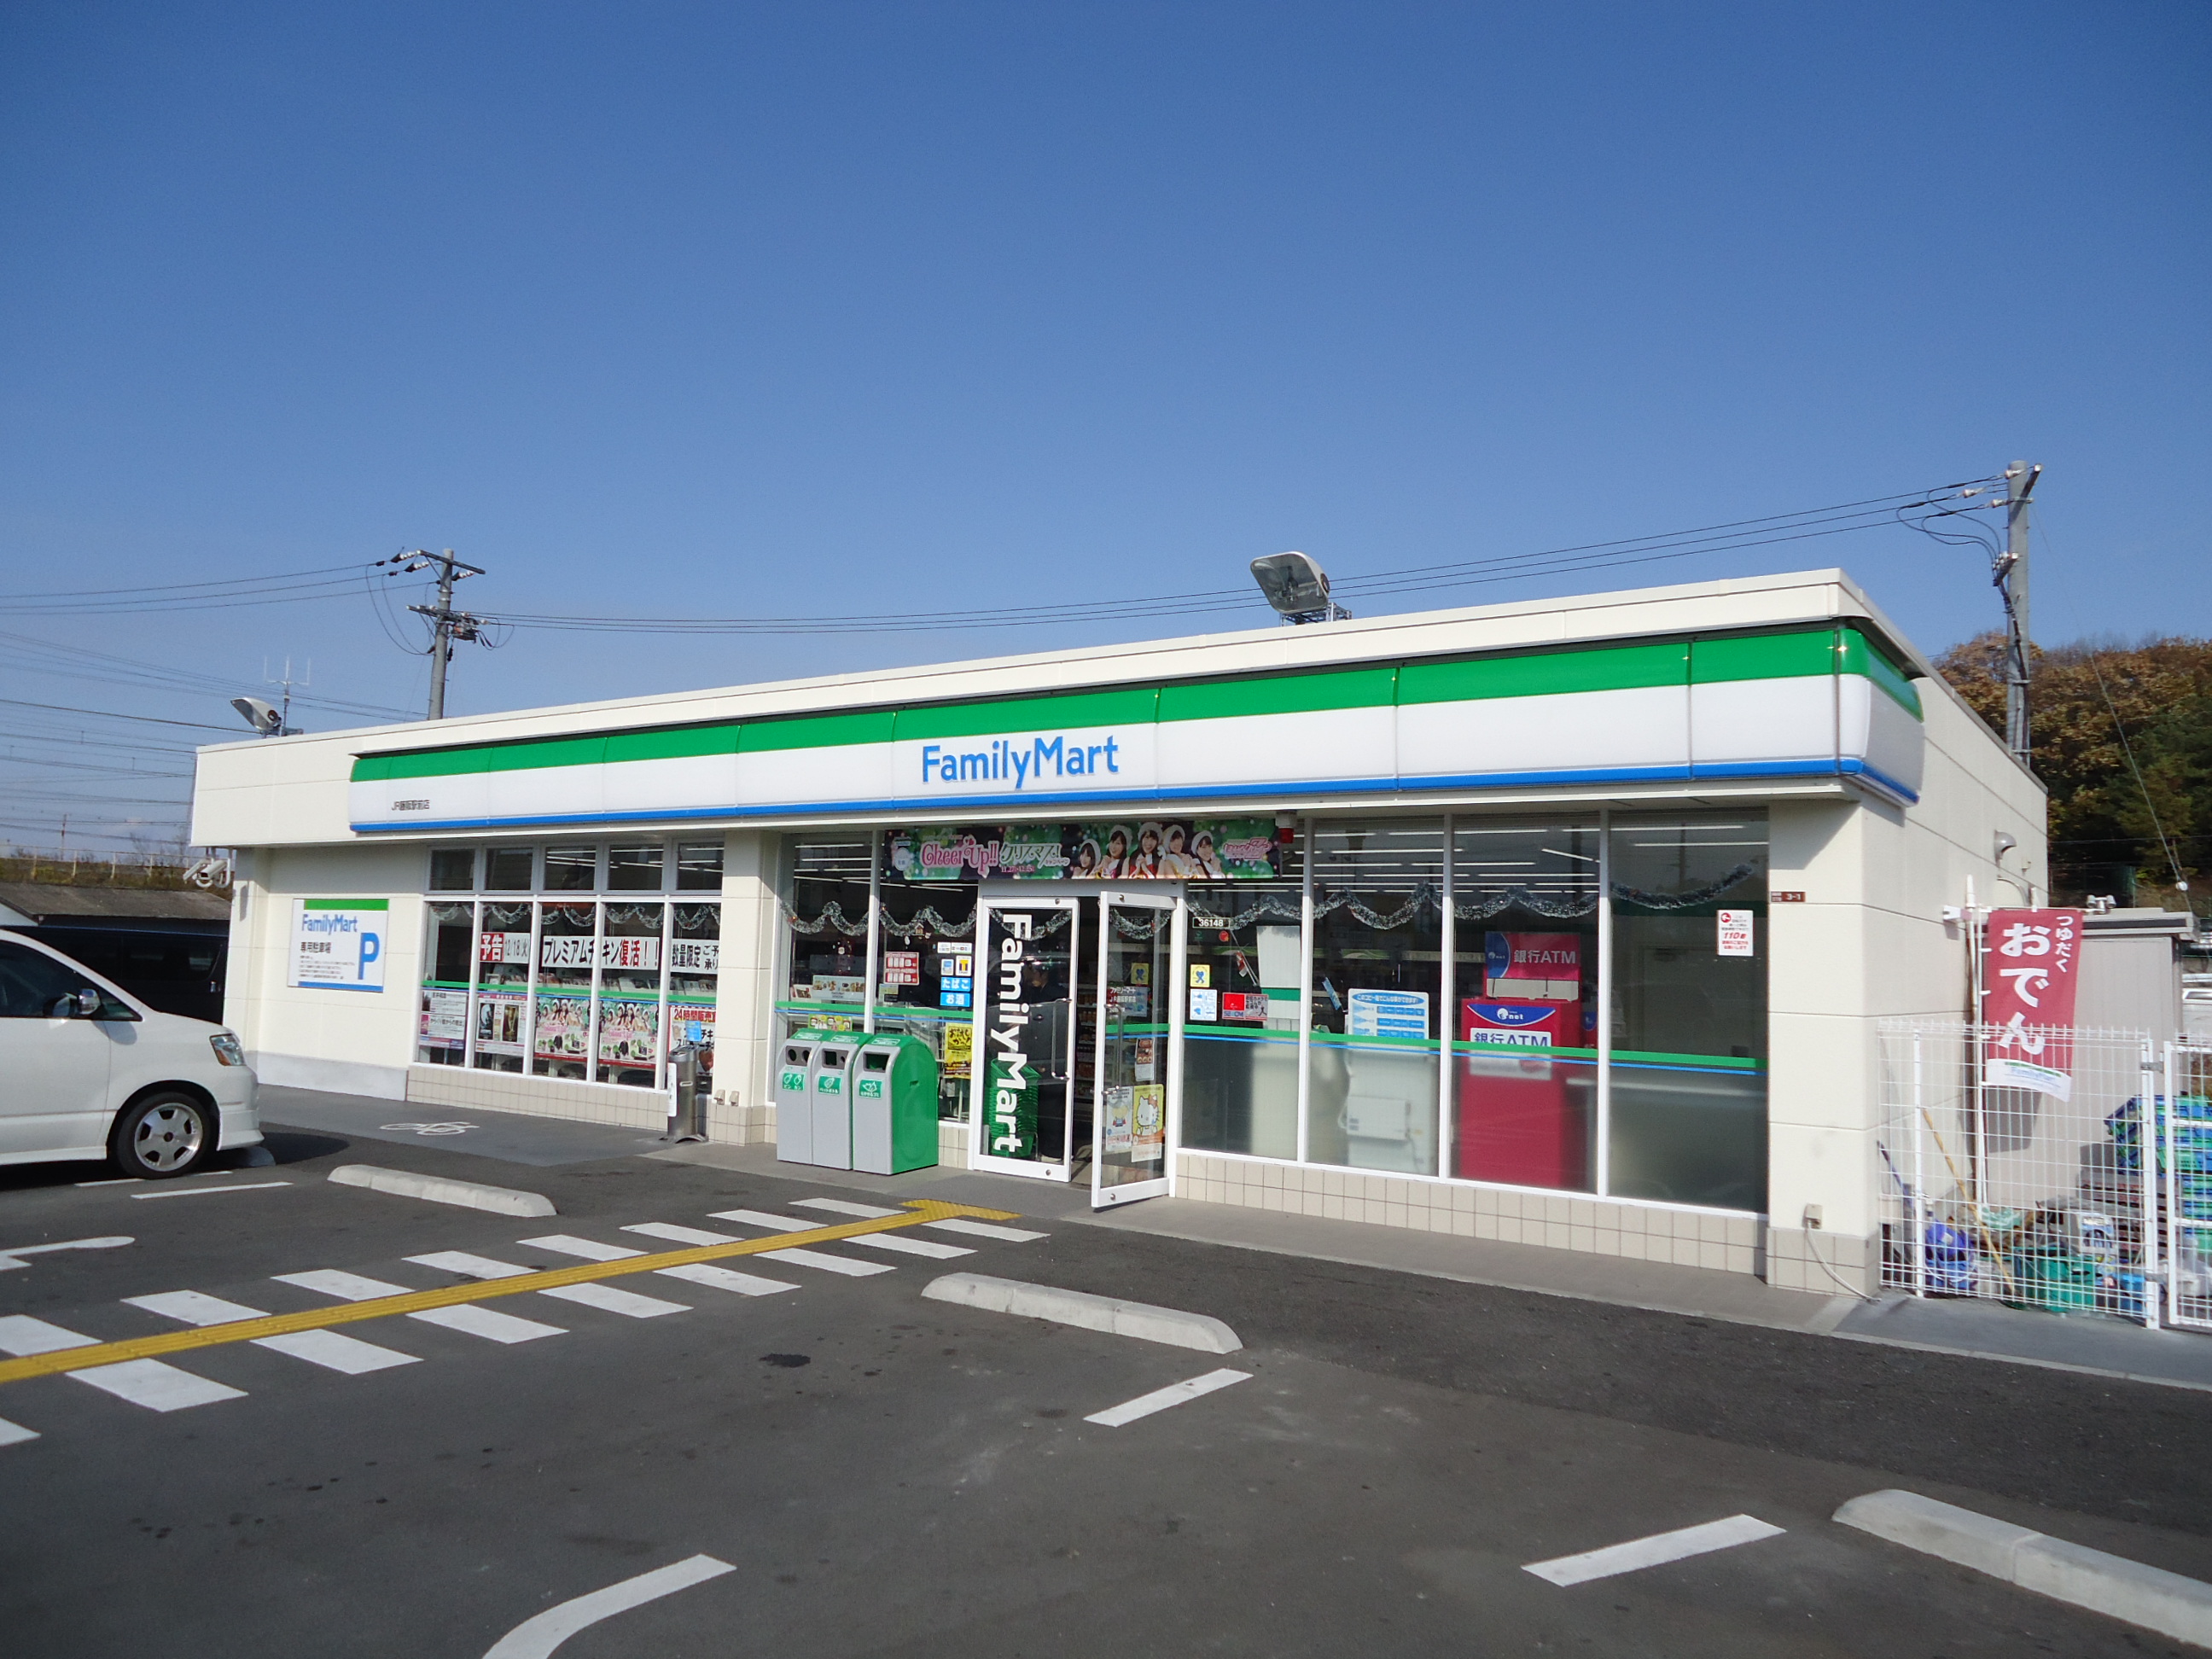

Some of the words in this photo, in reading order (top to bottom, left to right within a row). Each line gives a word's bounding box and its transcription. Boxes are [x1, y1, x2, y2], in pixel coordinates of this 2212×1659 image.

[923, 735, 1119, 789] FamilyMart
[922, 843, 963, 866] Cheer
[301, 913, 358, 935] FamilyMart
[358, 932, 381, 980] P
[480, 934, 503, 961] 予告
[672, 944, 701, 968] 数量限定
[2055, 916, 2074, 973] つゆだく
[1514, 950, 1576, 964] 銀行ATM
[942, 978, 969, 989] たばこ
[1999, 923, 2051, 1055] おでん
[946, 993, 964, 1004] お酒
[991, 913, 1032, 1153] FamilyMart
[1475, 1033, 1548, 1046] 銀行ATM
